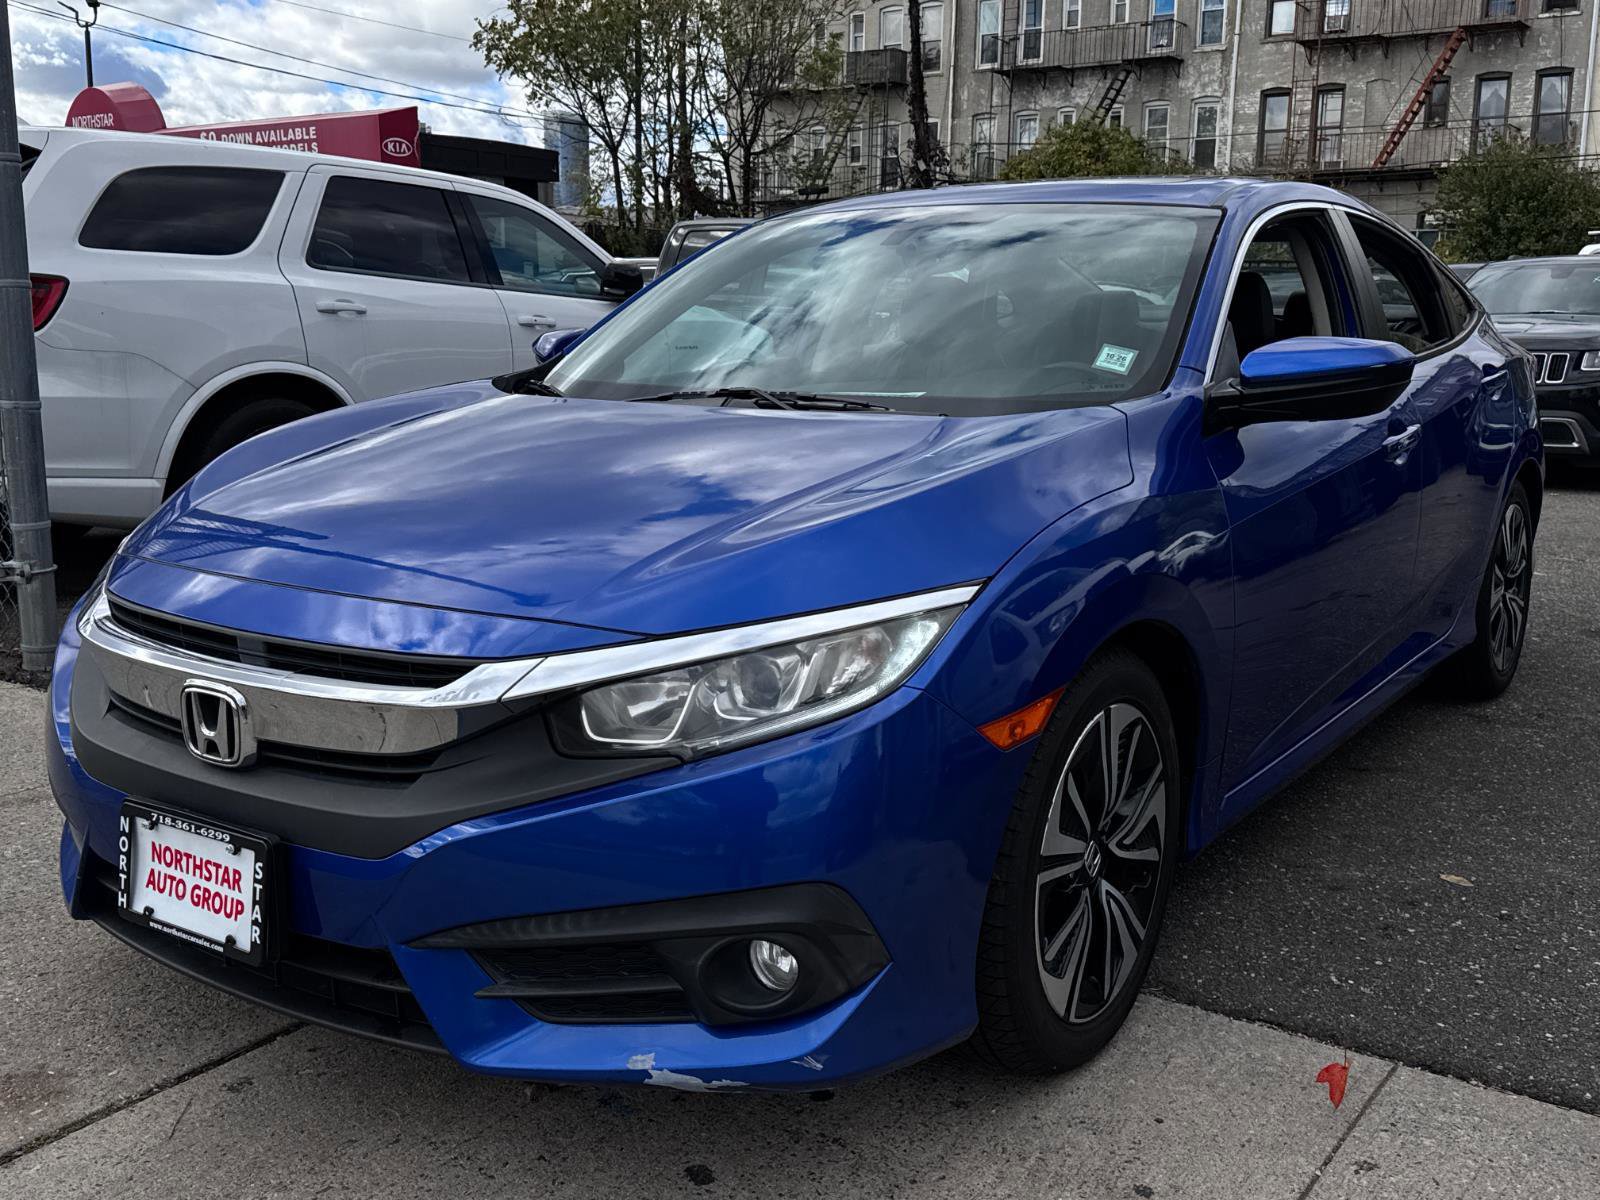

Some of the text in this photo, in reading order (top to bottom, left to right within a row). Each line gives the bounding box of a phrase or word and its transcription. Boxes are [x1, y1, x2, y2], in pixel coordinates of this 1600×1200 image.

[72, 113, 114, 128] NORTHSTAR
[221, 132, 253, 144] DOWN
[255, 126, 316, 143] AVAILABLE
[387, 141, 409, 153] KIA
[151, 813, 230, 842] 718-361-6299
[118, 816, 130, 909] NORTH
[151, 841, 242, 893] NORTHSTAR
[145, 868, 245, 922] AUTO GROUP
[251, 862, 263, 944] STAR
